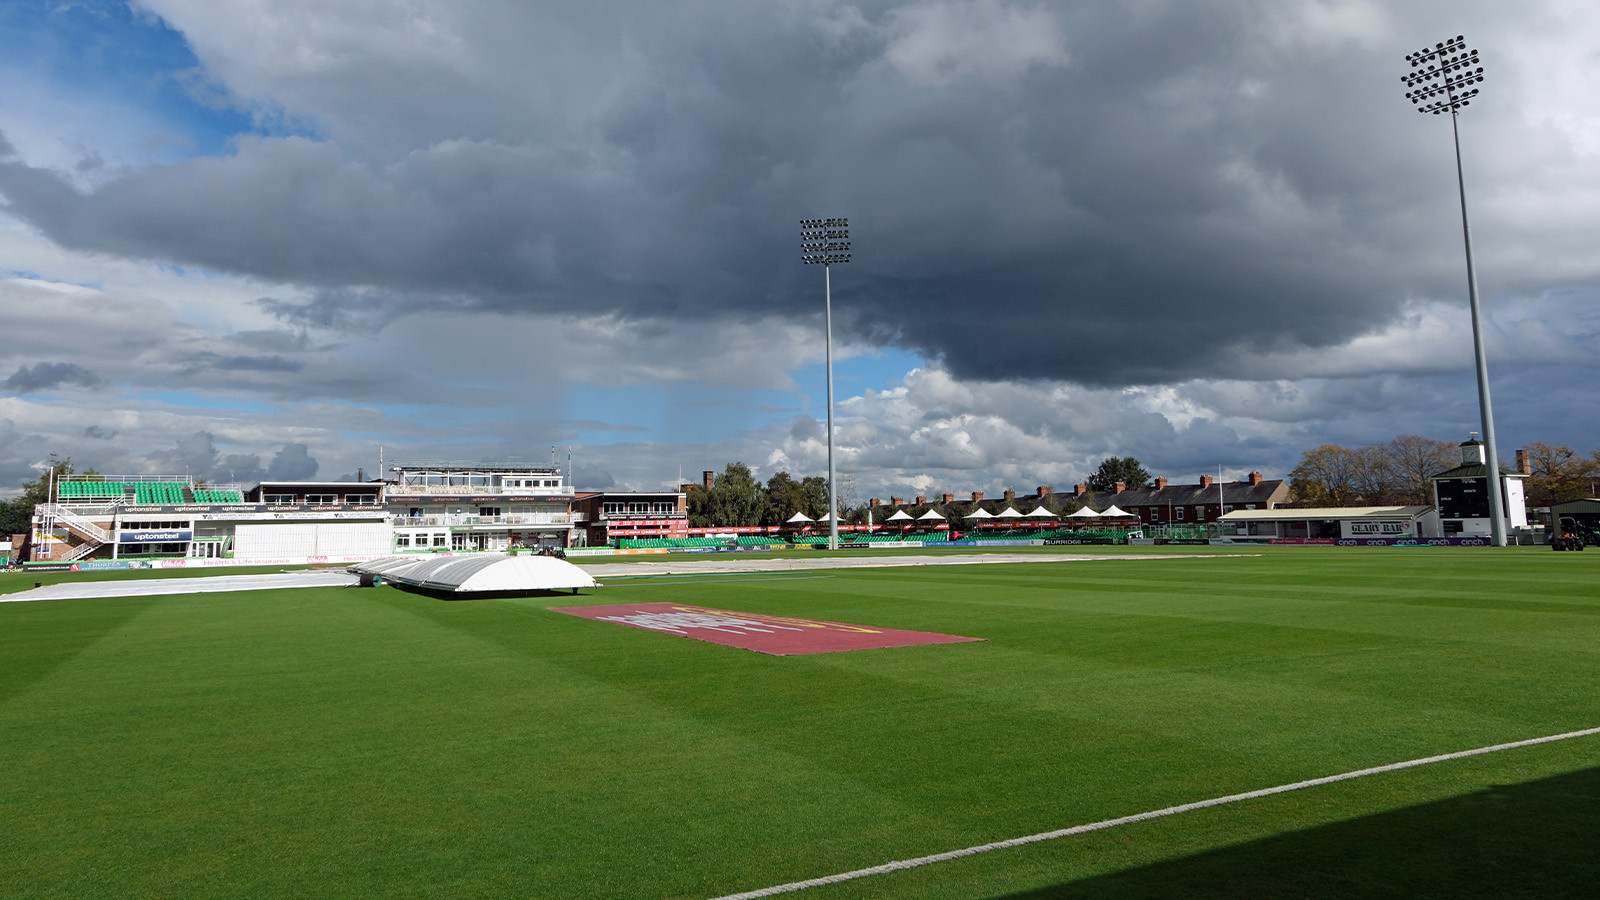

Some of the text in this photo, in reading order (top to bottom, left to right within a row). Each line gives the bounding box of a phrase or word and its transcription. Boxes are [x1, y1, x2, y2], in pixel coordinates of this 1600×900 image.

[1351, 524, 1403, 532] GEARY BAR
[134, 533, 179, 541] uptonsteel
